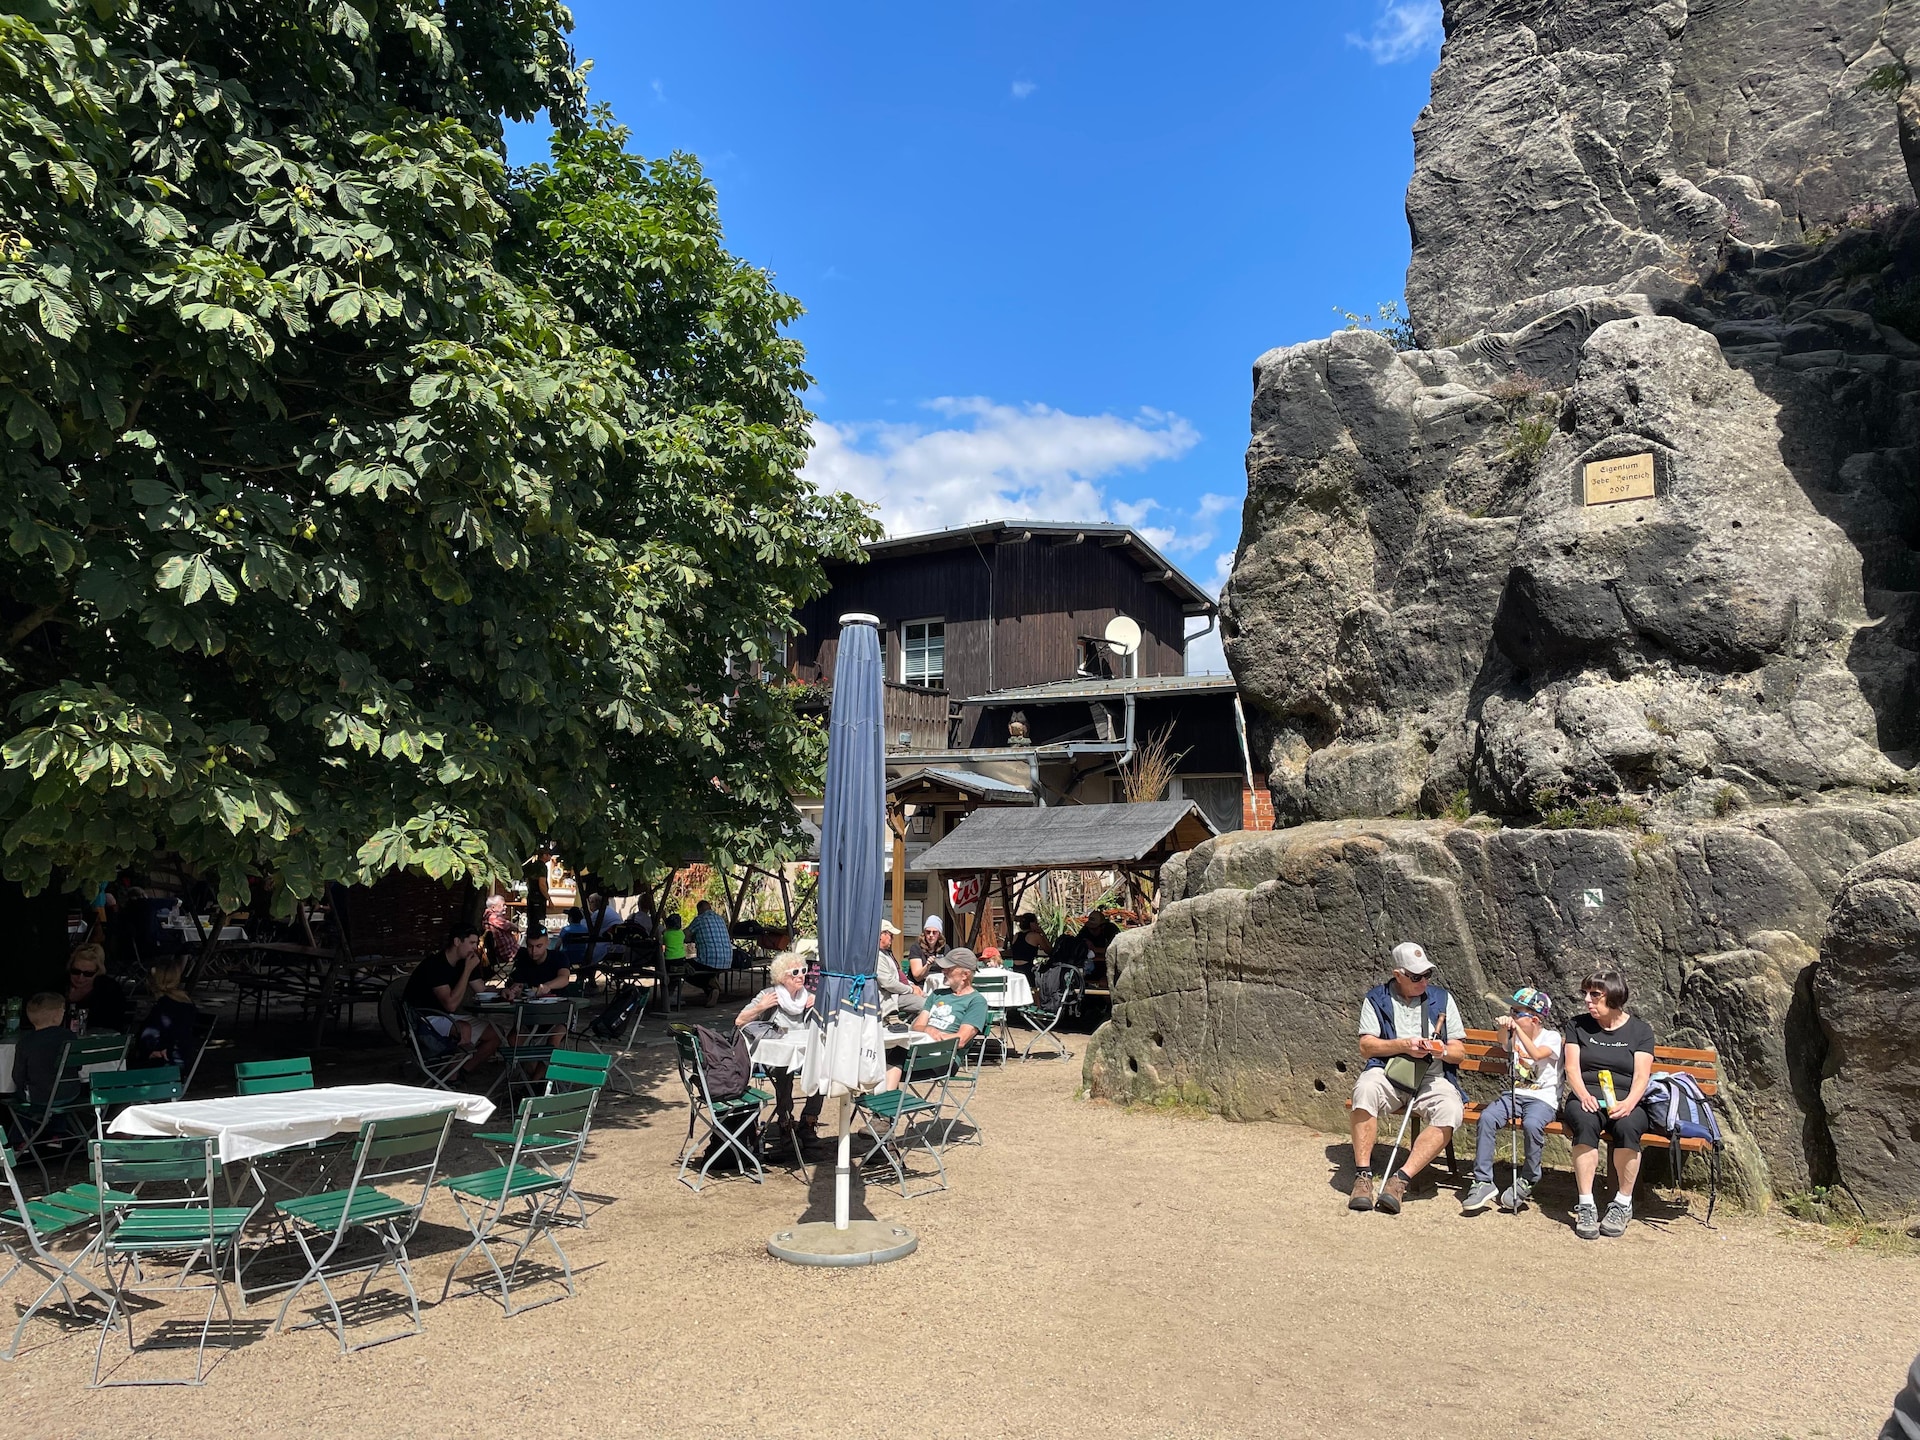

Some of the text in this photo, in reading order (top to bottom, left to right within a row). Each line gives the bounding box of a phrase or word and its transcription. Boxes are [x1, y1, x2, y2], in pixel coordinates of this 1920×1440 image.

[1599, 463, 1639, 474] Eigentum
[1609, 485, 1630, 494] 2007
[953, 878, 979, 905] Eis
